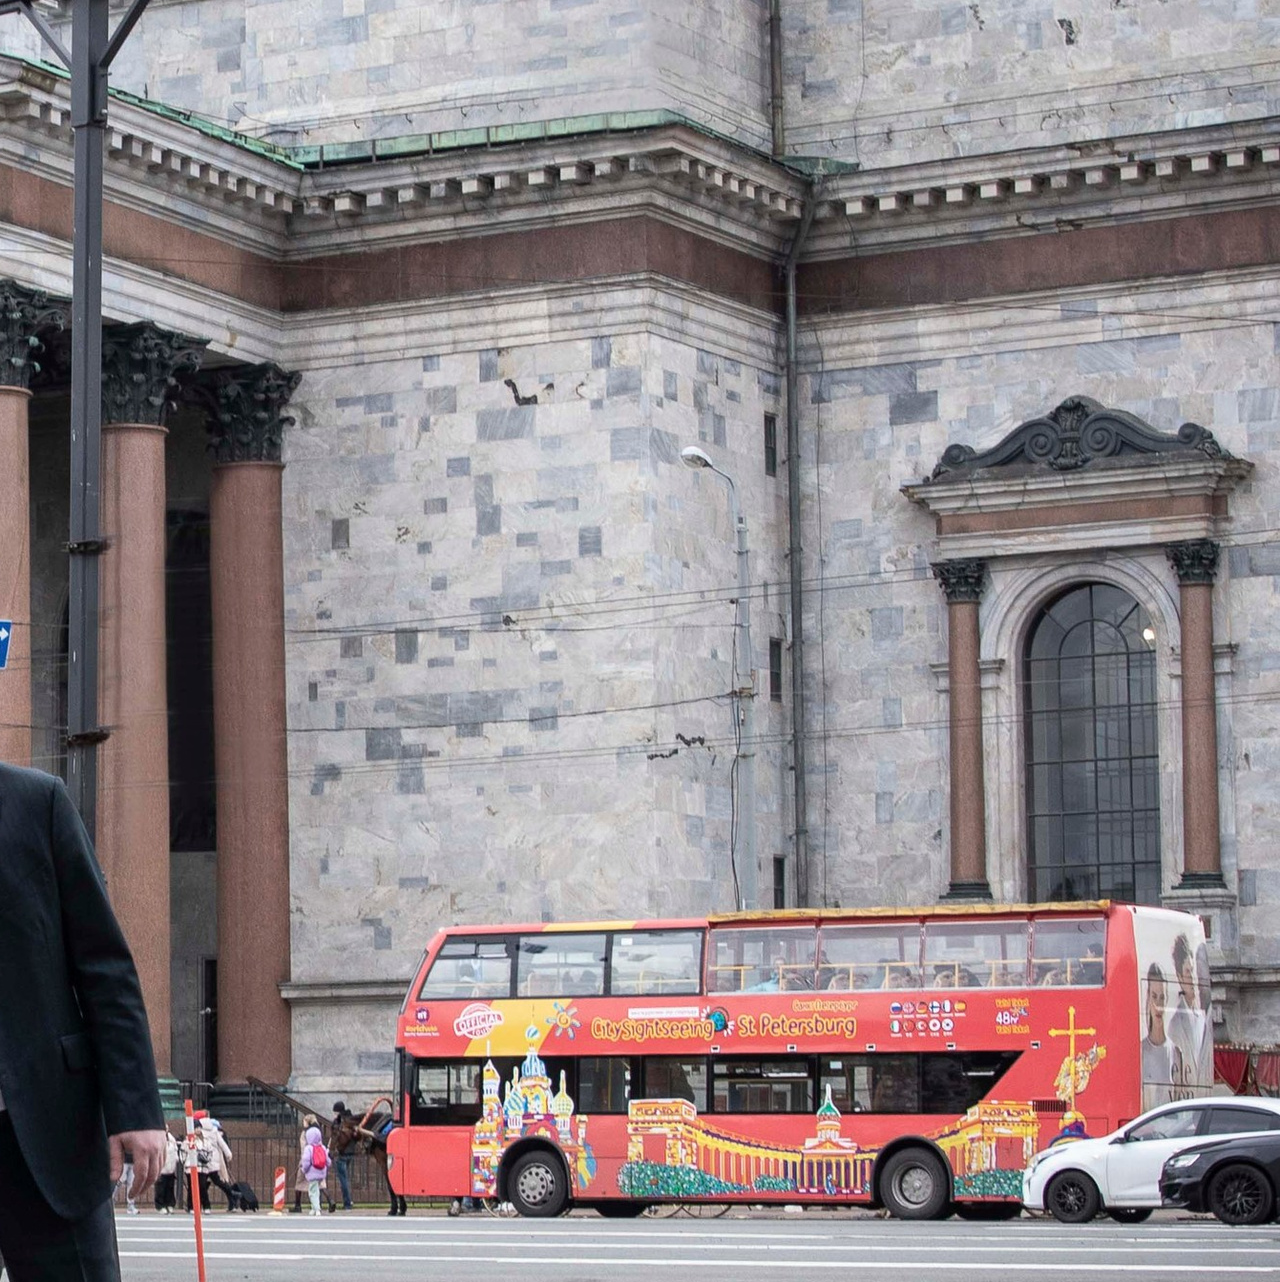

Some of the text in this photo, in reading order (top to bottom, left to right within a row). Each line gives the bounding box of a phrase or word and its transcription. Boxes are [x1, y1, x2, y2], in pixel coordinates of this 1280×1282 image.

[459, 1012, 501, 1031] OFFICIAL
[738, 1013, 857, 1039] St Petersburg
